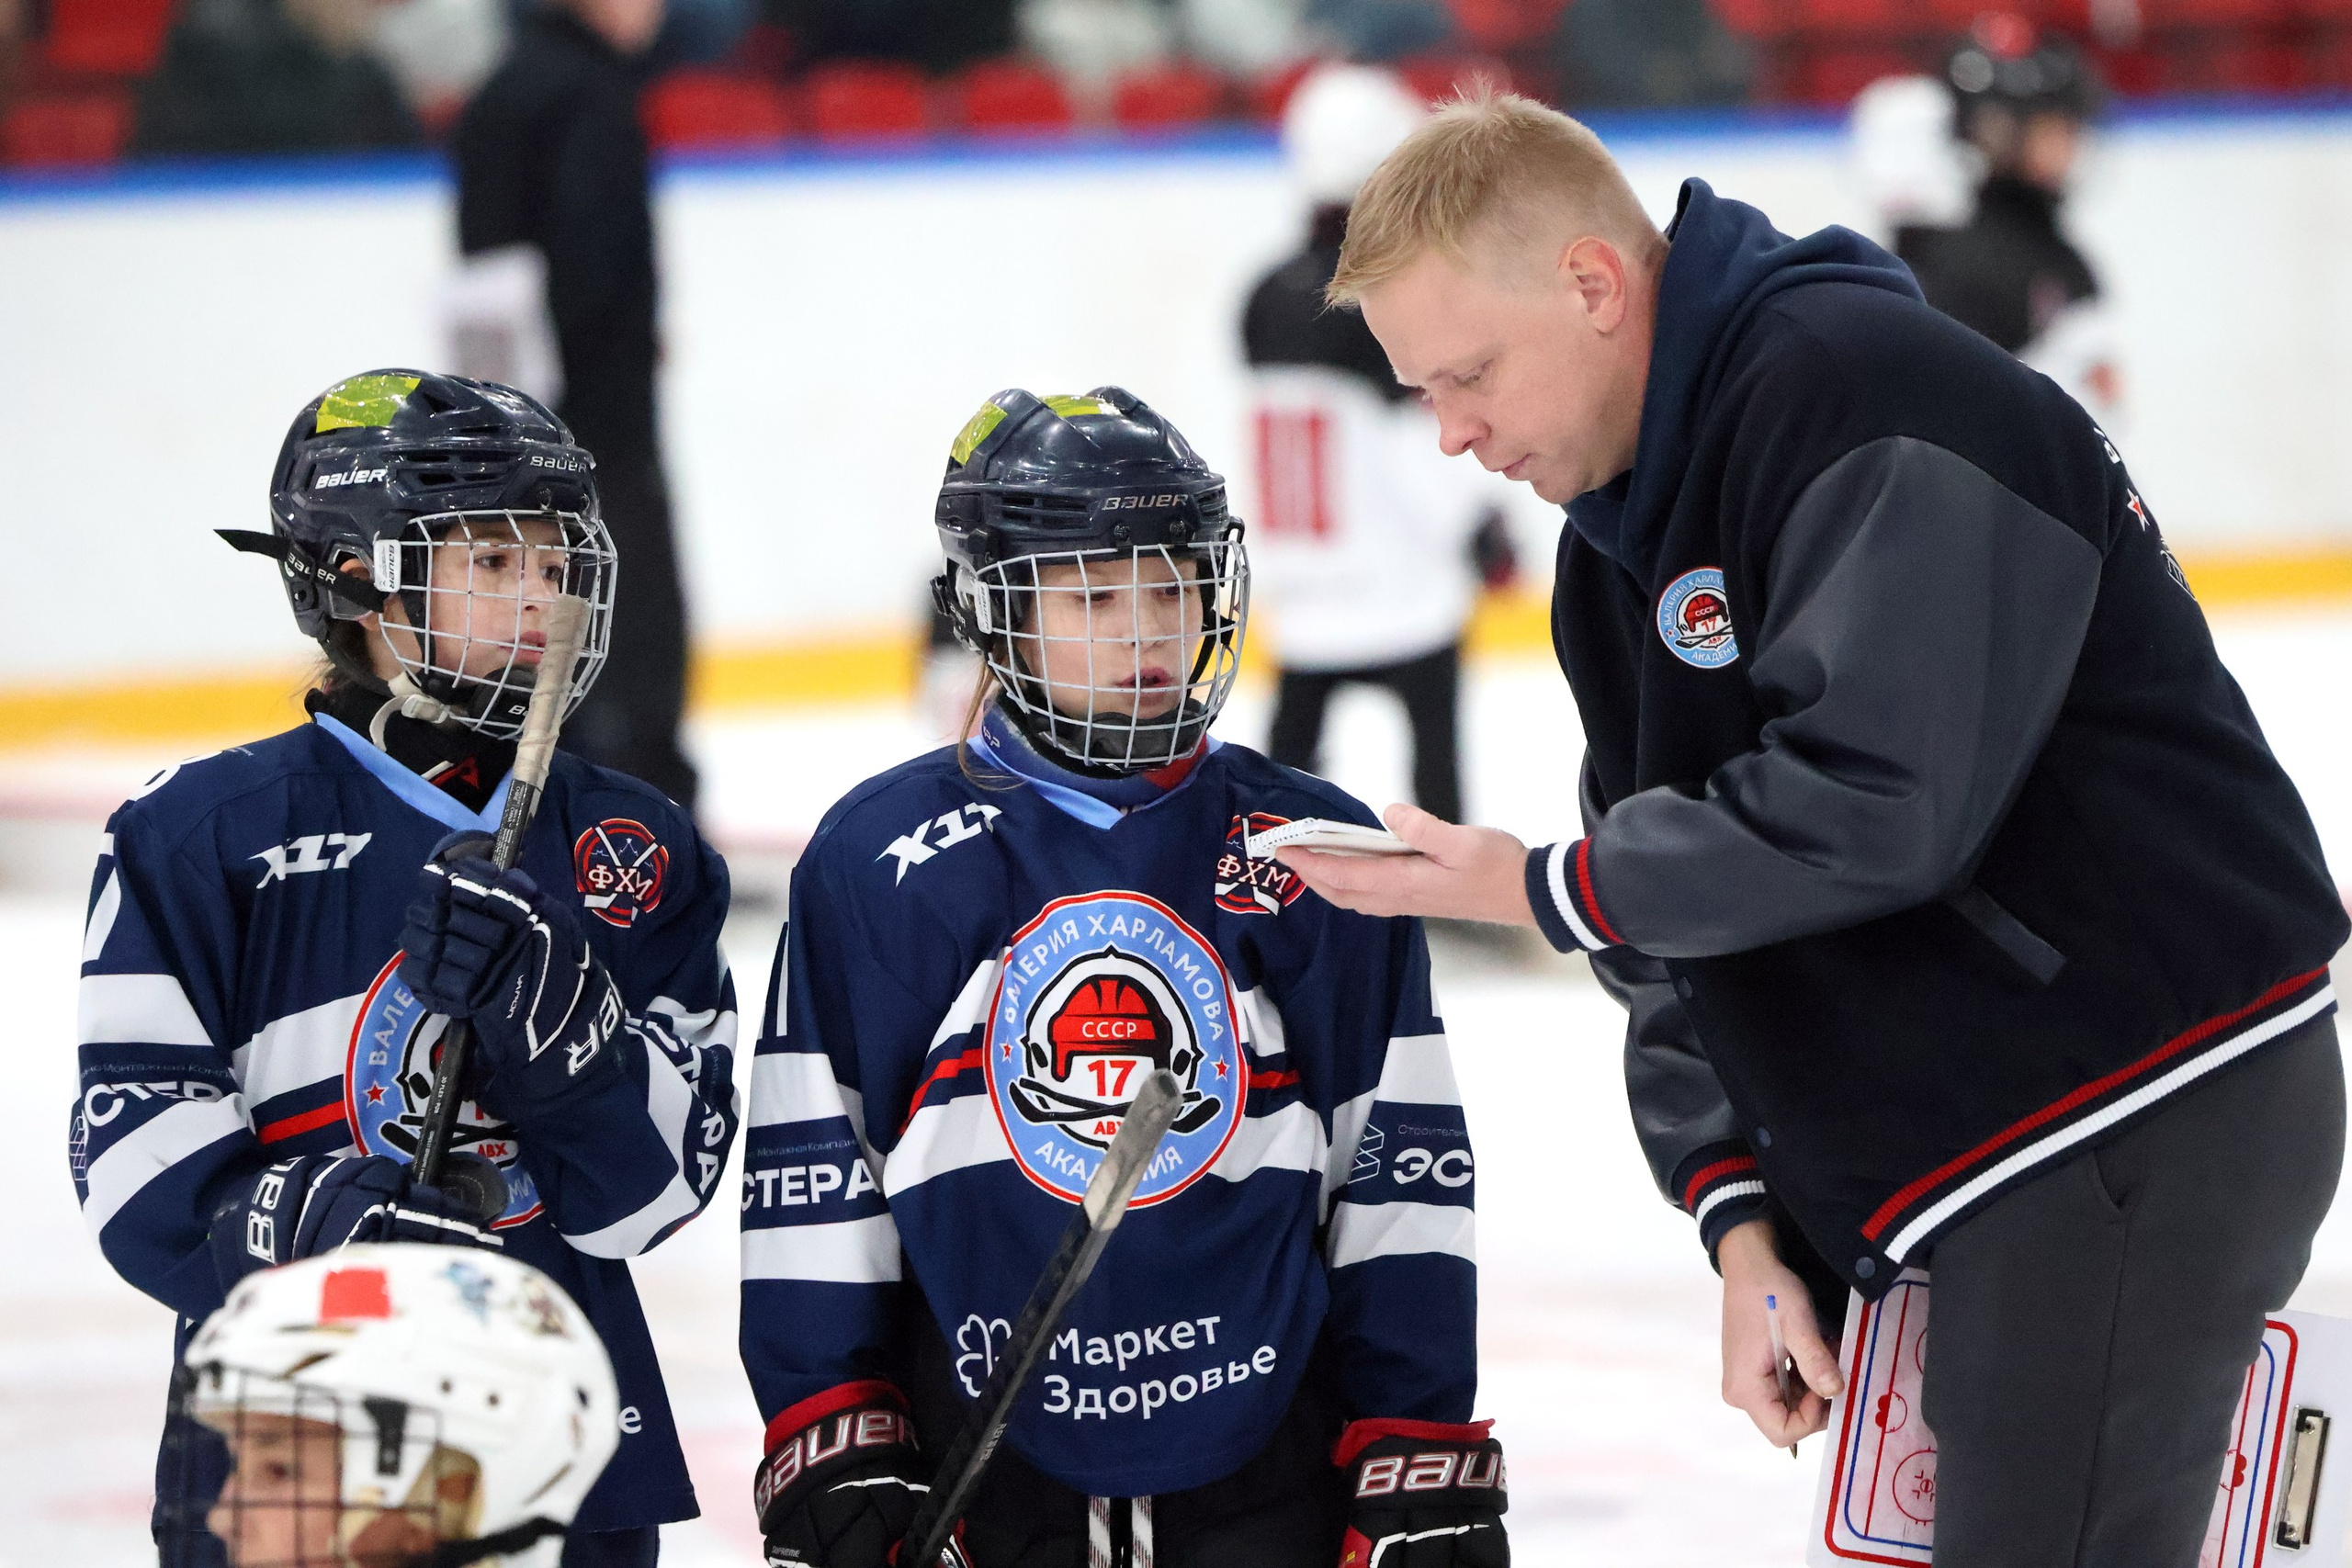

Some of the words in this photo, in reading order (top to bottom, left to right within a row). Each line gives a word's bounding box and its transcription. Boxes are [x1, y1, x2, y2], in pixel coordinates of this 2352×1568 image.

[1702, 616, 1718, 633] 17
[1691, 642, 1738, 663] АКАДЕМИ
[1217, 853, 1292, 895] ФХМ
[1087, 914, 1224, 1042] ХАРЛАМОВА
[368, 987, 415, 1066] ВАЛЕ
[1081, 1021, 1137, 1039] СССР
[1087, 1059, 1137, 1098] 17
[1093, 1121, 1122, 1135] АВ
[1048, 1315, 1221, 1371] Маркет
[1043, 1345, 1277, 1420] Здоровье
